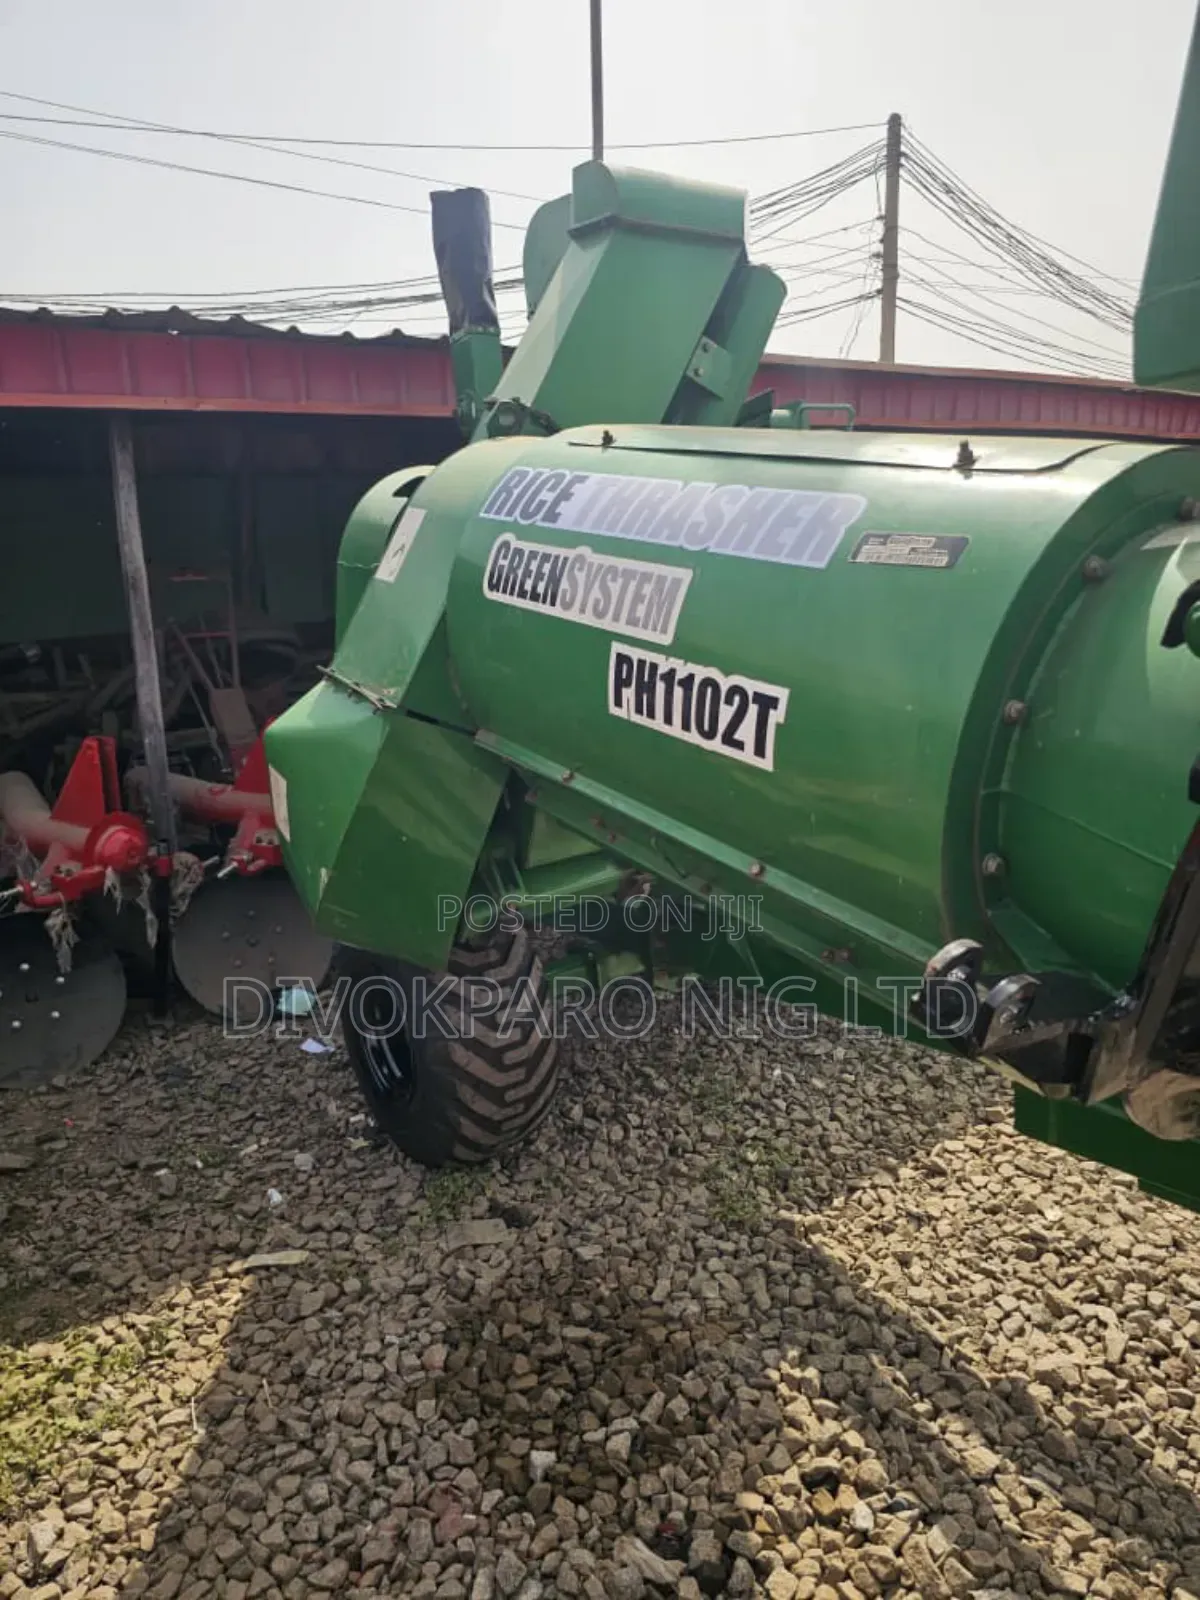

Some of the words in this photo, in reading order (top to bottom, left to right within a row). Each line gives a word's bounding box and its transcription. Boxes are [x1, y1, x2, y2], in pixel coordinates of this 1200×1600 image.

[485, 468, 587, 524] RICE
[572, 475, 858, 567] THRASHER
[613, 652, 780, 760] PH1102T
